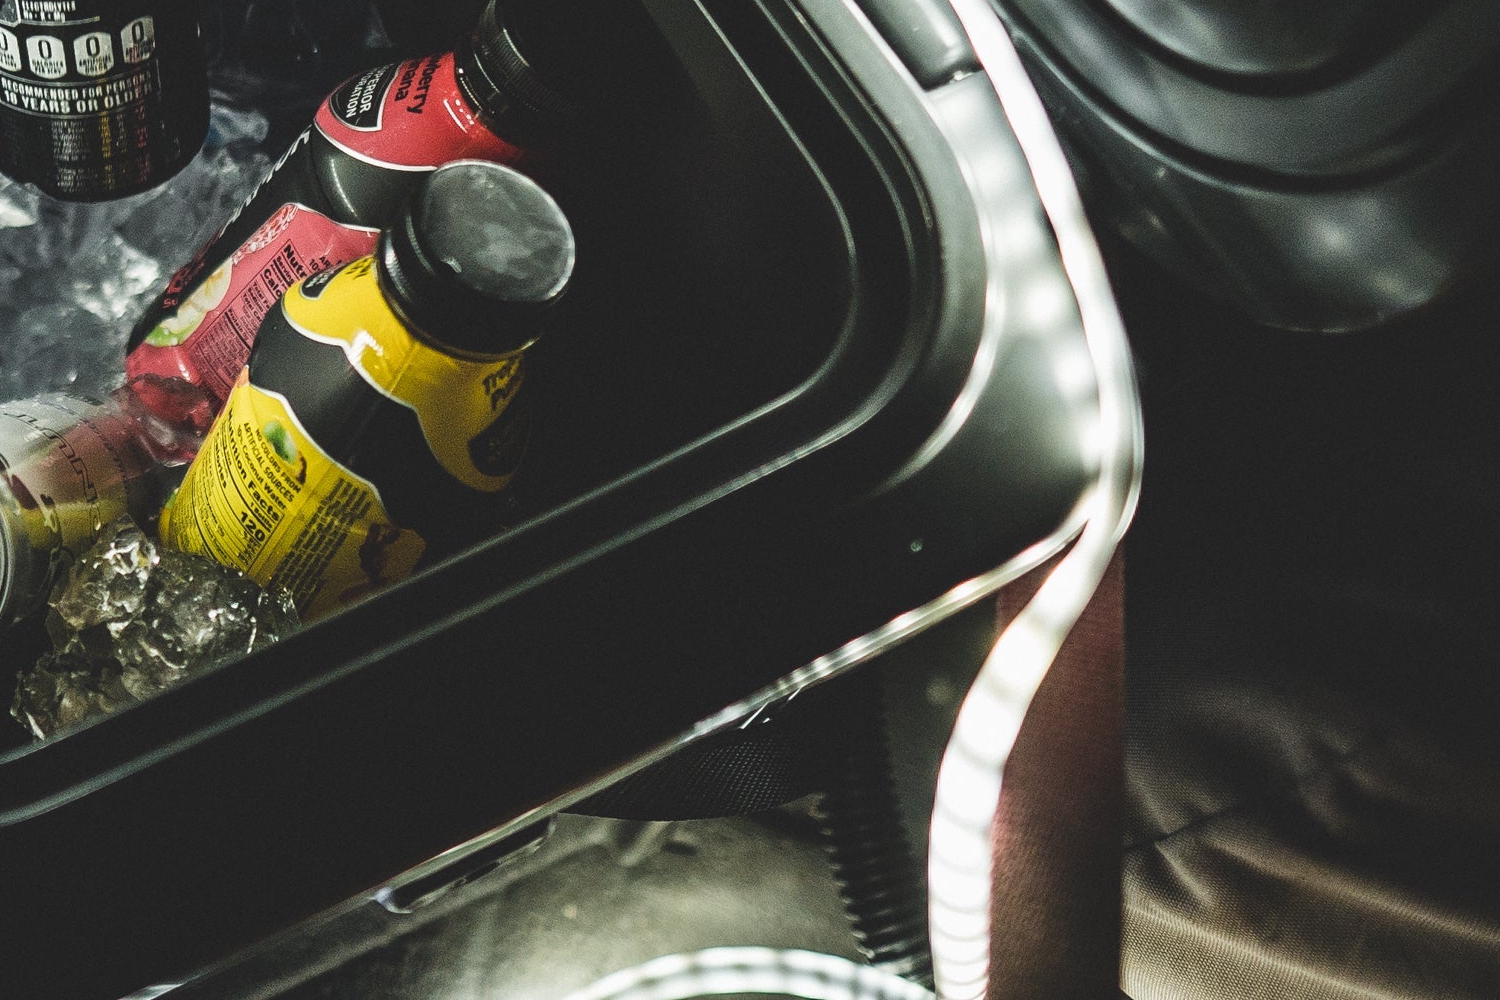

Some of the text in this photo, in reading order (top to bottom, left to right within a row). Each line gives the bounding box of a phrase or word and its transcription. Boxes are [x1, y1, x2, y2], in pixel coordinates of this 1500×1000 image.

[38, 39, 53, 60] 0
[85, 36, 101, 58] 0
[131, 20, 145, 44] 0
[1, 76, 79, 101] RECOMMENDED
[82, 85, 103, 100] FOR
[394, 59, 420, 102] nana
[406, 58, 441, 114] wberry
[21, 95, 71, 114] YEARS
[76, 99, 99, 113] OR
[228, 408, 247, 480] Nutrition
[247, 480, 280, 521] Facts
[242, 445, 264, 484] Coconut
[264, 482, 287, 510] Water
[243, 422, 295, 502] ARTIFICIAL SOURCES
[255, 428, 302, 494] NO COLORS FROM
[240, 510, 265, 542] 120
